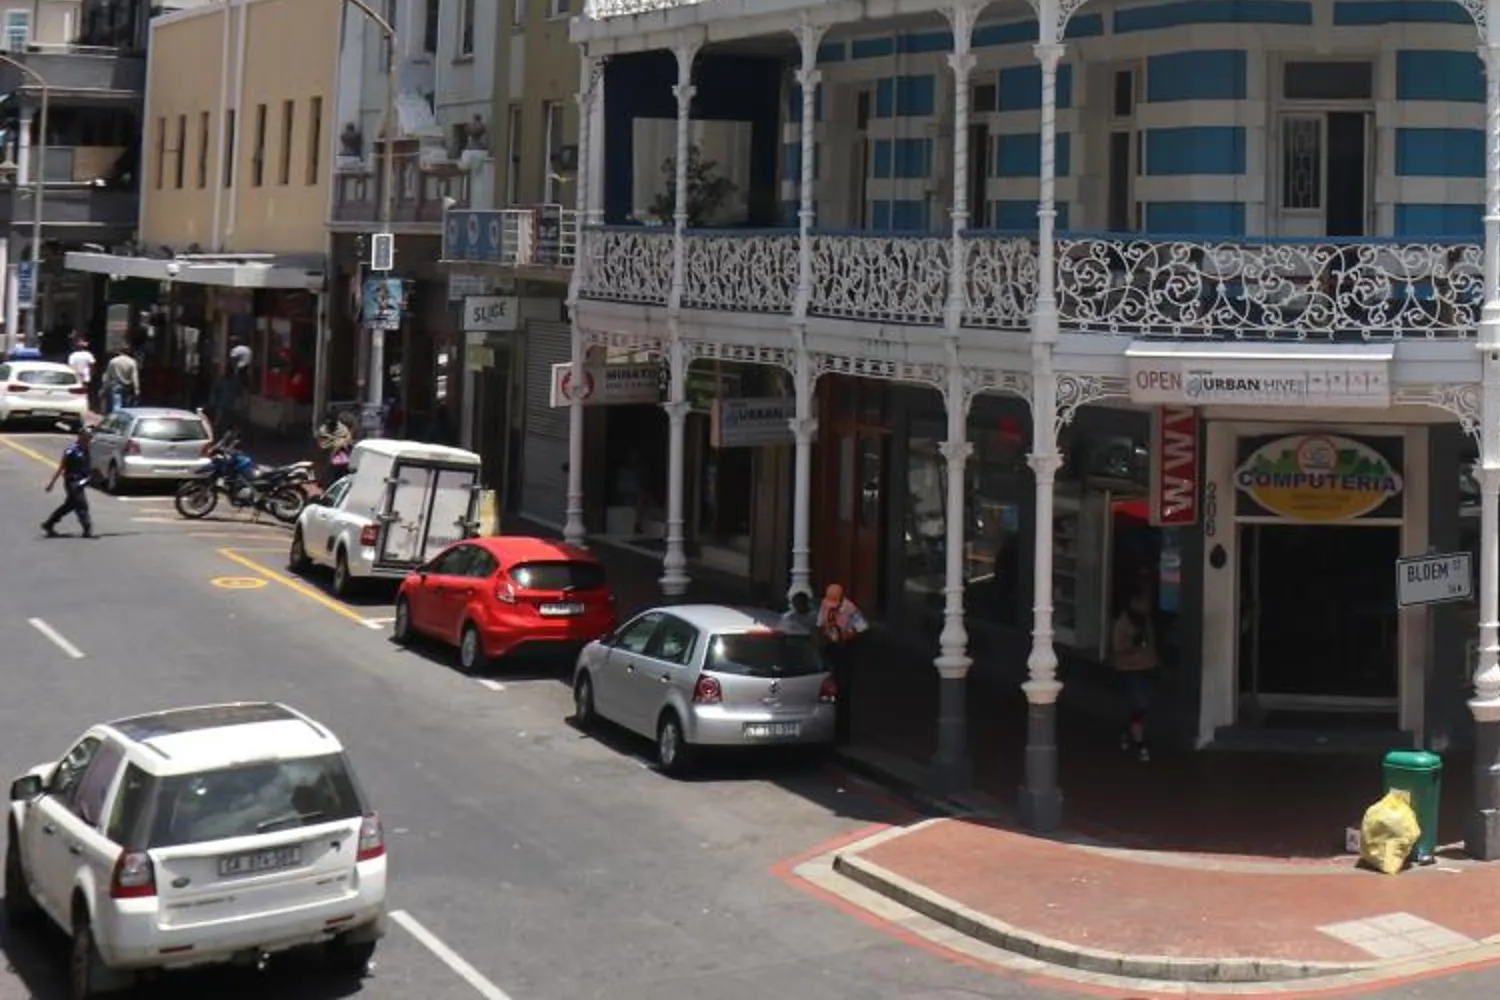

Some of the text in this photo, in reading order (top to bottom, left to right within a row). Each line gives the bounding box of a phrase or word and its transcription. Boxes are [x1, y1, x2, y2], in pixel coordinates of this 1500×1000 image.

[1136, 370, 1182, 391] OPEN
[1203, 377, 1260, 391] URBAN
[1237, 470, 1397, 493] COMPUTERIA
[1407, 561, 1449, 583] BLOEM
